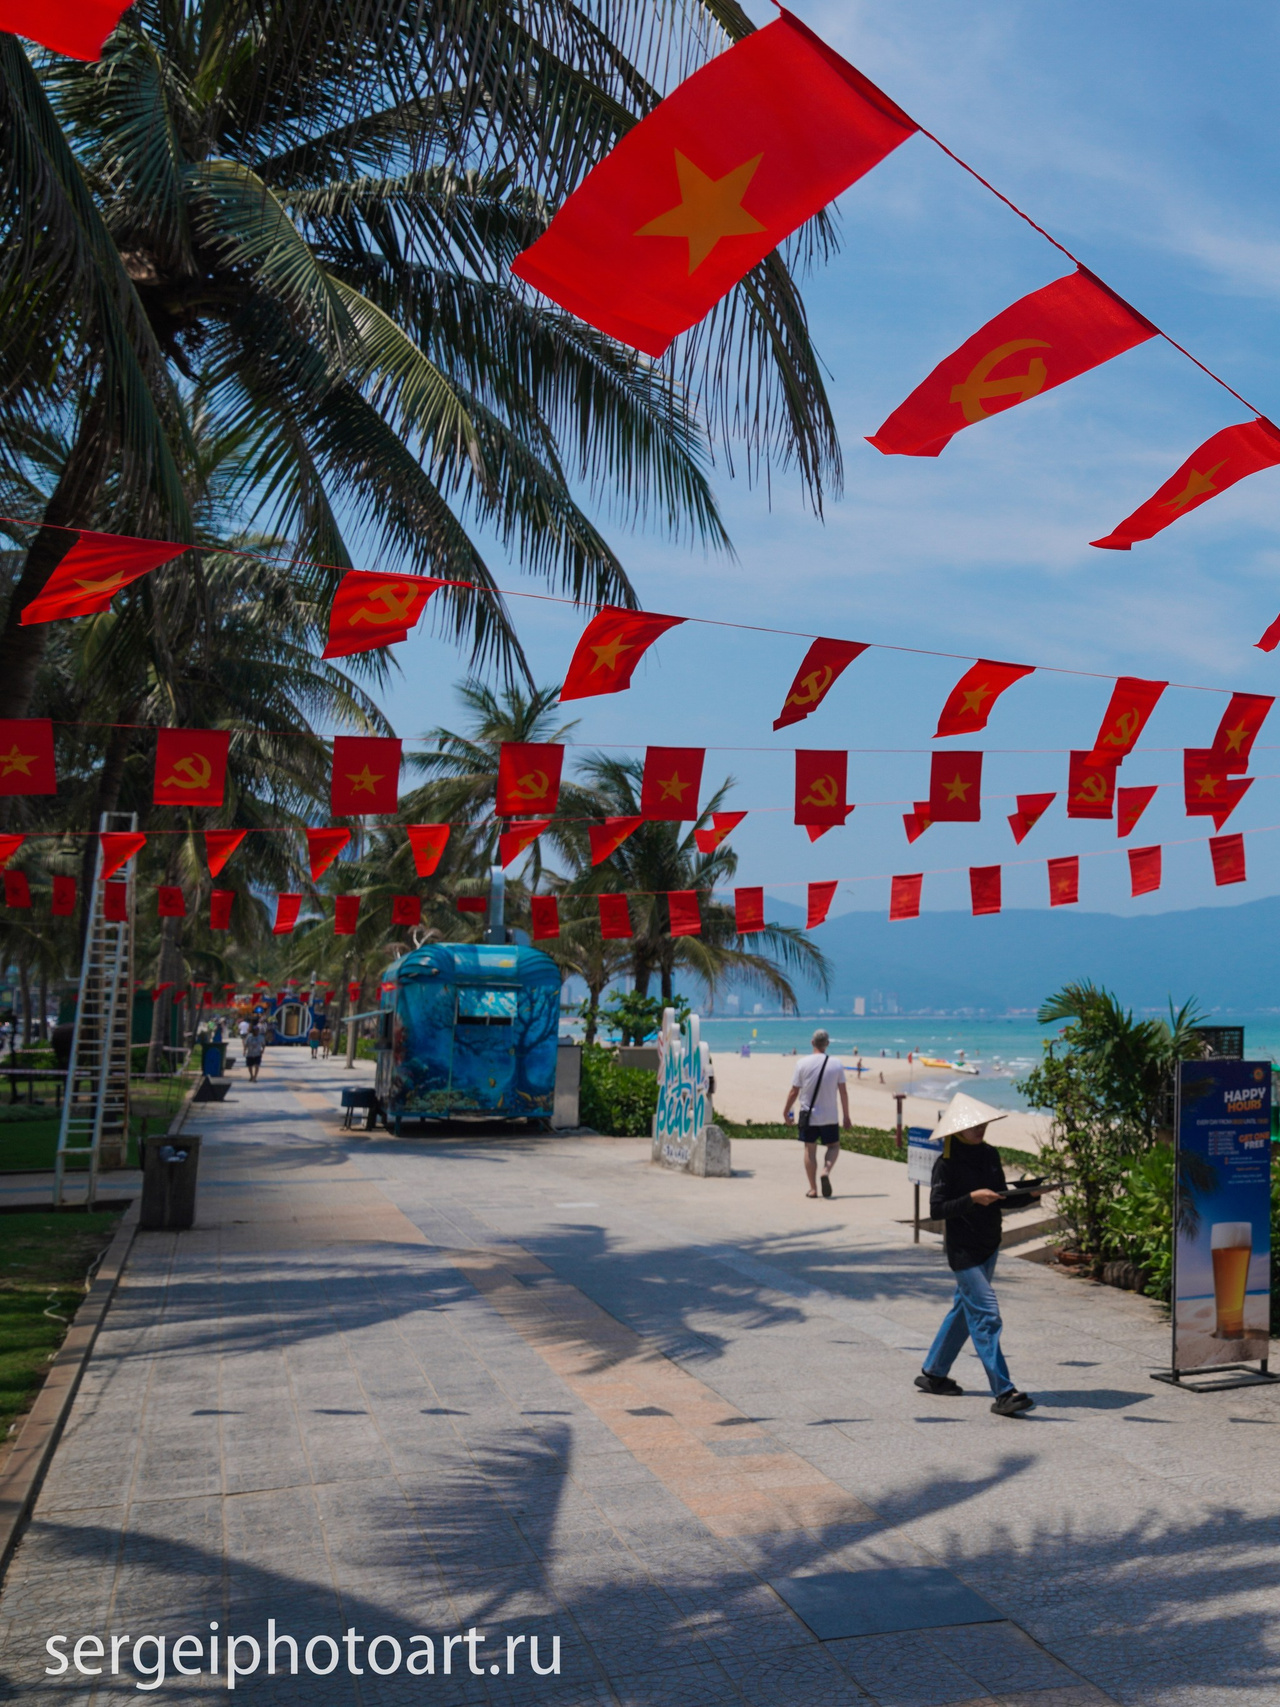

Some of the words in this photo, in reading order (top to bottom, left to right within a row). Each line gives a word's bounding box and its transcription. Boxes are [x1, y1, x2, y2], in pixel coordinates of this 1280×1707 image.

[1224, 1087, 1266, 1103] HAPPY
[1227, 1100, 1262, 1113] HOURS
[1239, 1133, 1253, 1143] GET
[1244, 1140, 1265, 1150] FREE
